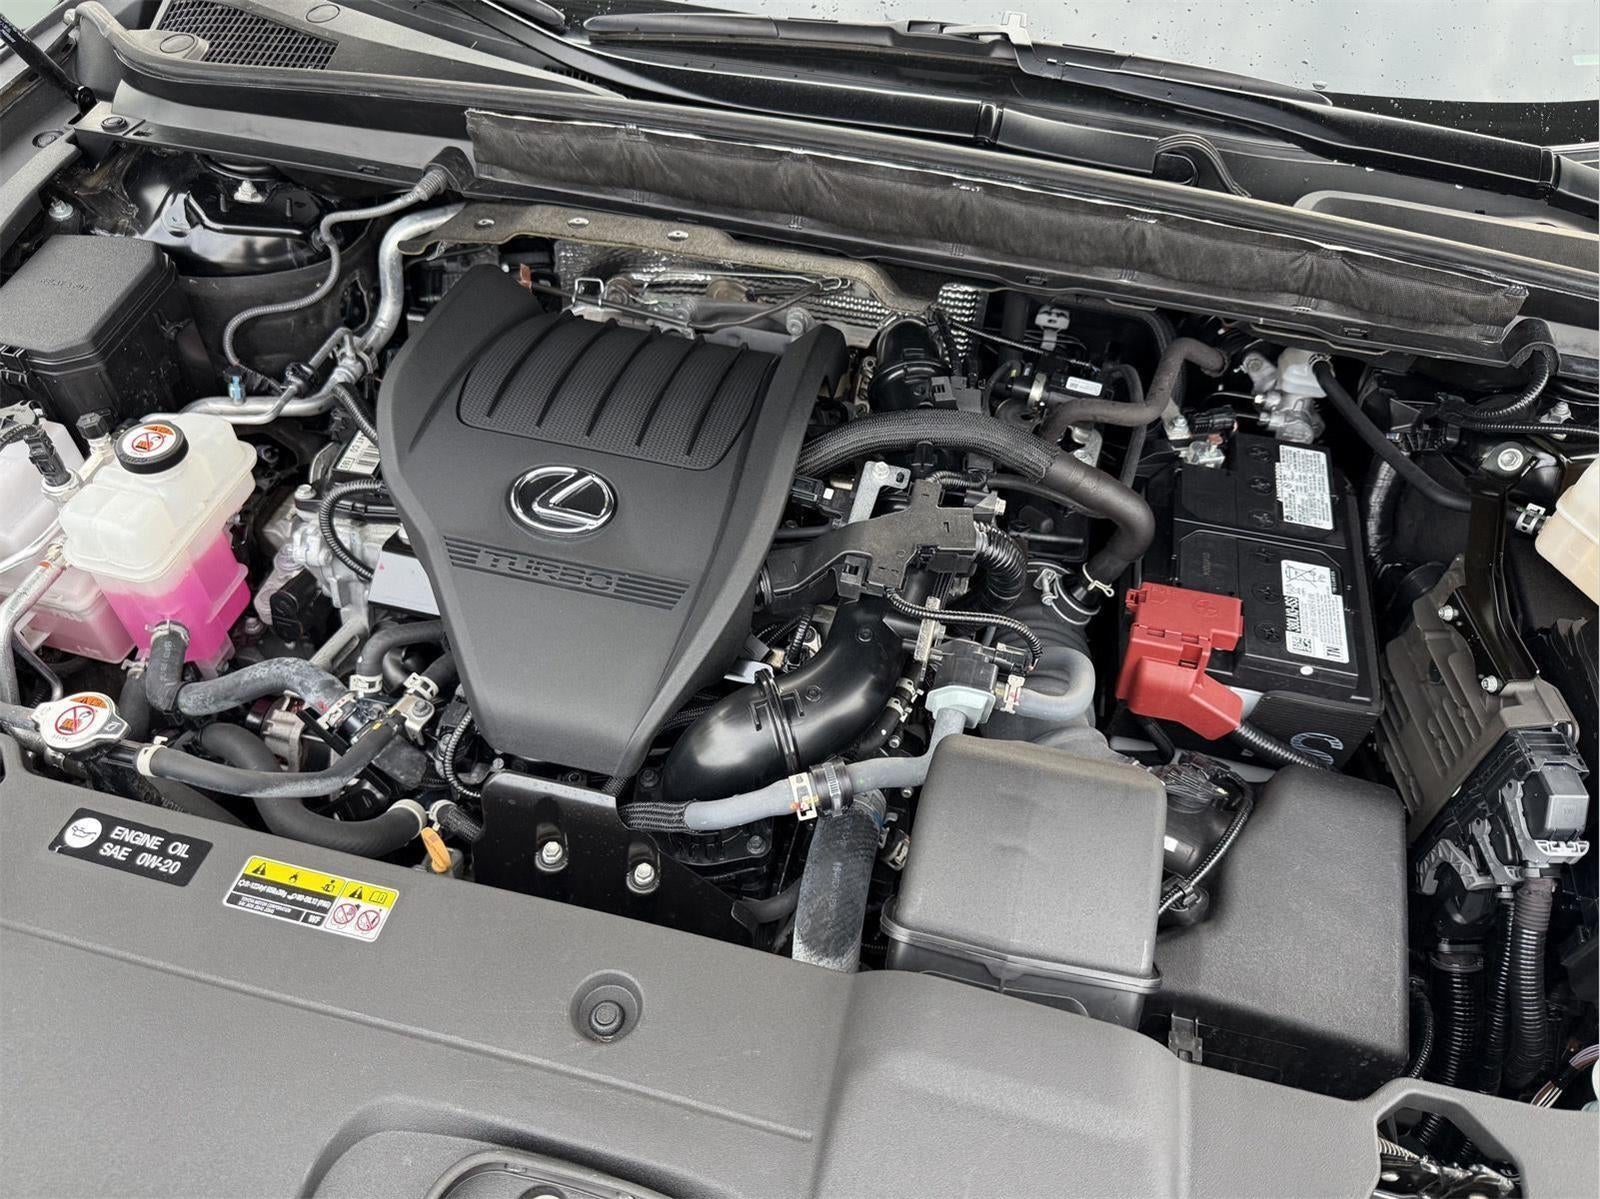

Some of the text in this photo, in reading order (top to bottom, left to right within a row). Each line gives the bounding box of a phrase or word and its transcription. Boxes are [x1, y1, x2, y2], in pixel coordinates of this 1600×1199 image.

[478, 549, 617, 592] TURBO
[99, 842, 181, 875] SAE 0W-20
[110, 825, 191, 859] ENGINE OIL
[308, 914, 321, 923] WF
